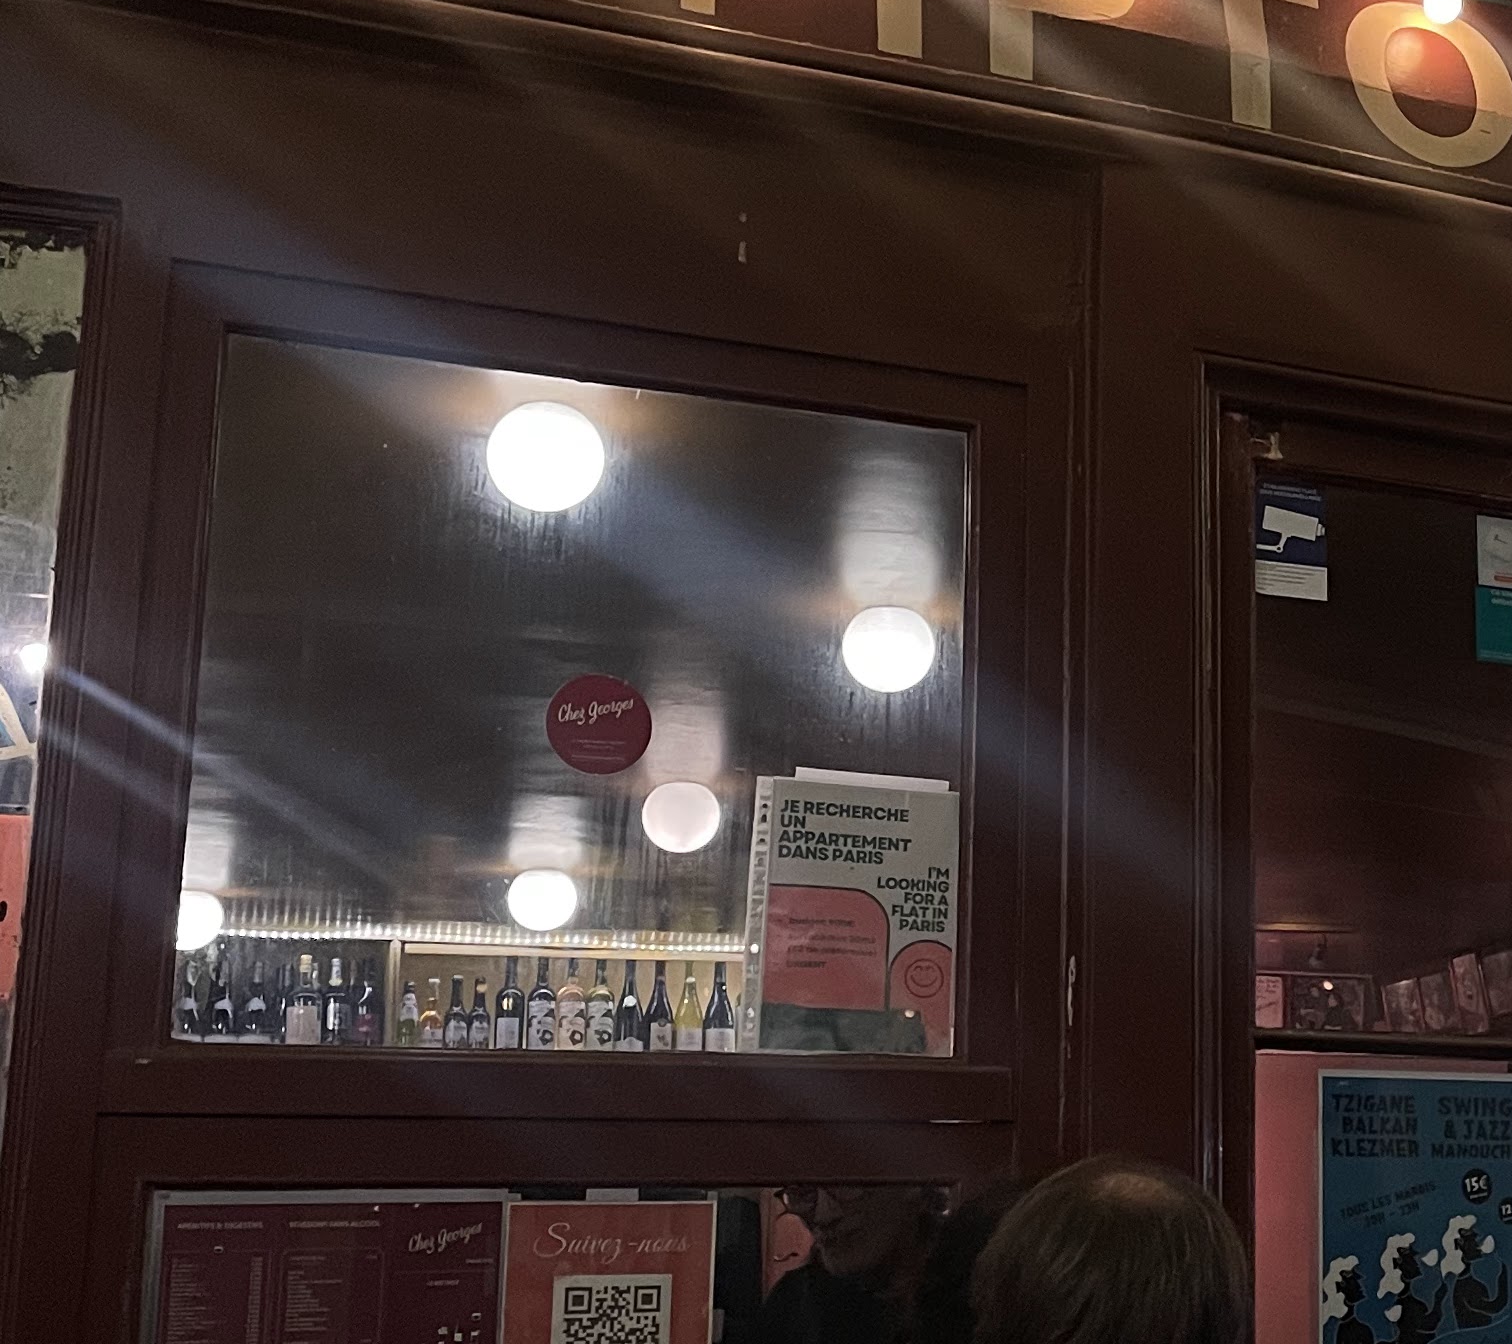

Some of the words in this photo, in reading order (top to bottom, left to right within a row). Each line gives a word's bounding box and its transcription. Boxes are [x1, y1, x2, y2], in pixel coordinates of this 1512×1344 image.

[557, 702, 586, 726] Chez
[588, 699, 634, 725] Georges
[780, 799, 800, 814] JE
[803, 801, 910, 823] RECHERCHE
[780, 814, 806, 829] UN
[778, 830, 912, 852] APPARTEMENT
[778, 844, 830, 861] DANS
[832, 848, 884, 865] PARIS
[927, 866, 950, 880] I'M
[876, 877, 950, 893] LOOKING
[904, 892, 935, 906] FOR
[937, 895, 949, 907] A
[891, 905, 930, 919] FLAT
[932, 907, 949, 920] IN
[899, 919, 946, 933] PARIS
[1331, 1094, 1415, 1114] TZIGANE
[1342, 1116, 1418, 1135] BALKAN
[1443, 1120, 1456, 1140] &
[1463, 1120, 1512, 1142] JAZZ
[1331, 1138, 1420, 1158] KLEZMER
[1463, 1174, 1489, 1194] 15€
[1371, 1194, 1393, 1210] LES
[408, 1233, 436, 1255] Chez
[436, 1221, 483, 1253] Georges
[532, 1221, 688, 1265] Suivez-nous
